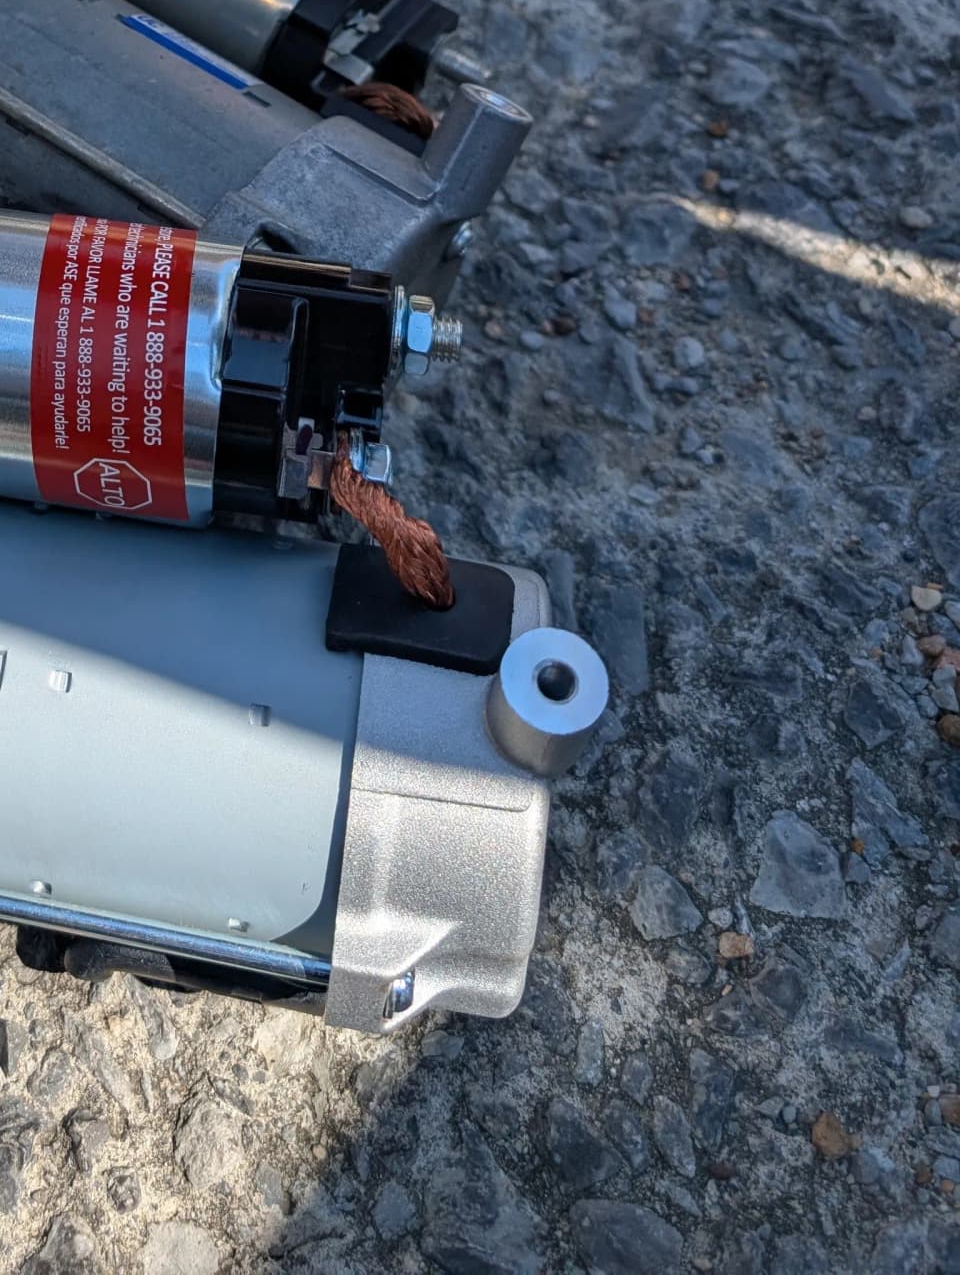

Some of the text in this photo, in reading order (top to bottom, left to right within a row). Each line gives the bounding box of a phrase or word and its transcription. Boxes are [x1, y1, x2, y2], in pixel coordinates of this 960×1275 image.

[65, 244, 79, 260] por
[88, 236, 106, 264] FAVOR
[152, 243, 174, 279] PLEASE
[63, 260, 79, 281] ASE
[83, 265, 101, 304] LLAME
[58, 282, 73, 305] que
[118, 273, 137, 302] who
[148, 281, 169, 315] CALL
[80, 306, 96, 323] AL
[115, 304, 130, 329] are
[147, 318, 166, 328] 1
[54, 307, 70, 358] esperan
[52, 361, 66, 390] para
[107, 333, 130, 392] waiting
[77, 337, 92, 433] 888-933-9065
[144, 331, 165, 446] 888-933-9065
[111, 397, 128, 413] to
[51, 393, 70, 449] ayudarle!
[107, 416, 130, 454] help!
[98, 462, 126, 507] ALTO
